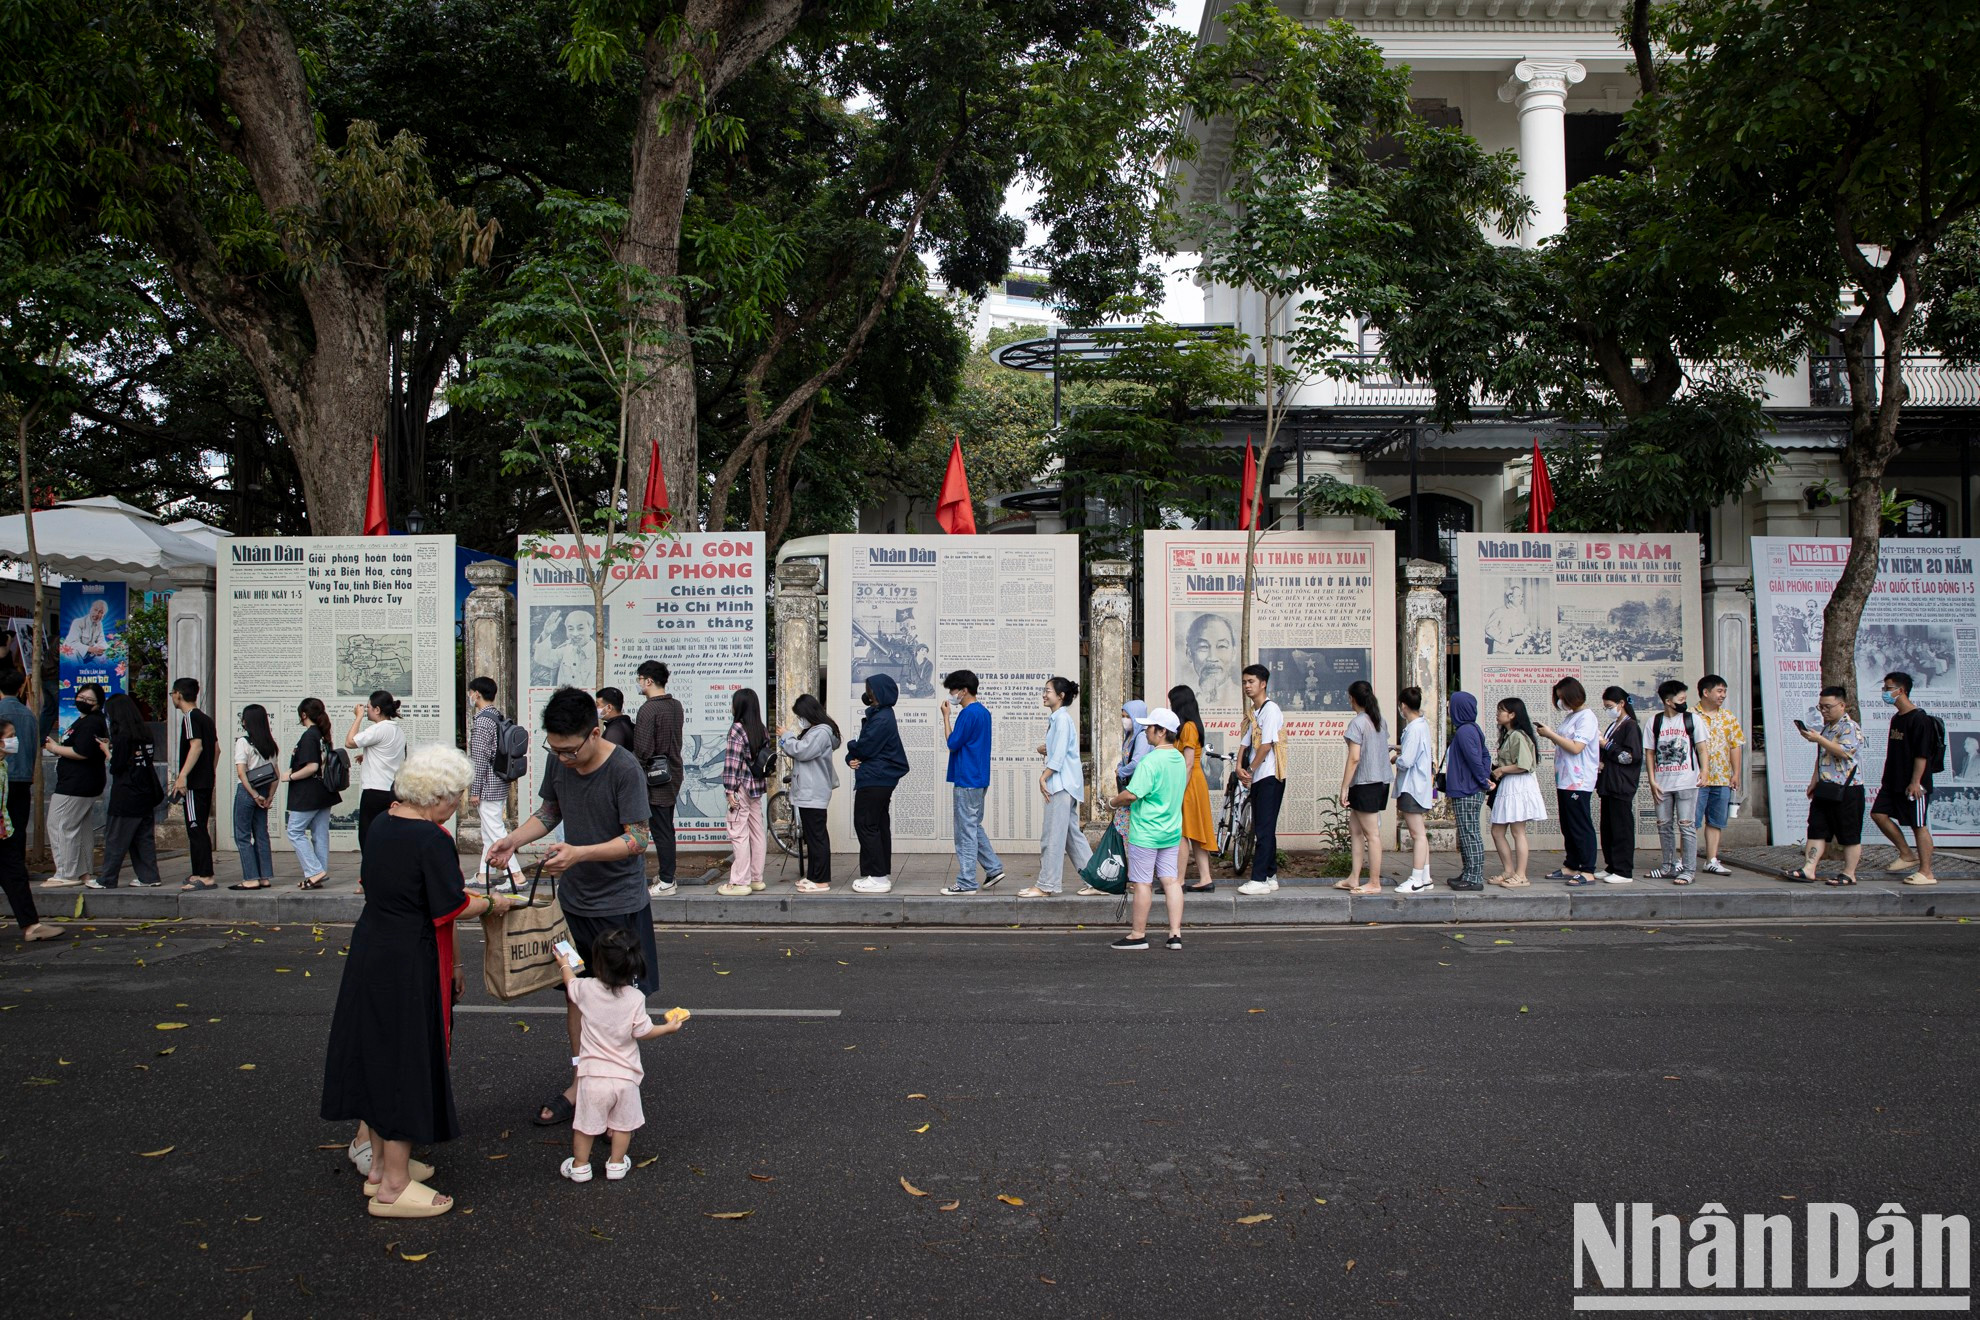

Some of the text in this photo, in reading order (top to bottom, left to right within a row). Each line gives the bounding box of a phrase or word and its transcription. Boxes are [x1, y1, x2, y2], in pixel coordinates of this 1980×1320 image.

[232, 545, 304, 562] Nhân Dân
[656, 541, 692, 558] SÀI
[702, 540, 753, 557] GÒN
[870, 548, 906, 562] Nhân
[910, 548, 936, 562] Dân
[1478, 541, 1552, 558] Nhân Dân
[1586, 542, 1672, 559] 15 NĂM
[1790, 545, 1832, 561] Nhân
[309, 553, 412, 564] Giải phóng hoàn toàn
[1202, 553, 1212, 564] 10
[1217, 552, 1240, 564] NĂM
[1268, 551, 1303, 564] THẮNG
[1308, 552, 1332, 564] MÙA
[1337, 552, 1366, 564] XUÂN
[611, 561, 752, 579] GIẢI PHÓNG
[1556, 561, 1572, 570] NGÀY
[1578, 560, 1598, 570] THẮNG
[1603, 561, 1615, 571] LỢI
[1620, 561, 1638, 570] HOÀN
[1642, 561, 1658, 570] TOÀN
[1664, 562, 1681, 571] CUỘC
[1891, 556, 1923, 574] NIỆM
[1926, 559, 1942, 574] 20
[1946, 556, 1972, 573] NĂM
[309, 567, 319, 578] thị
[341, 567, 360, 576] Biên
[366, 567, 385, 577] Hòa,
[391, 567, 412, 578] cảng
[533, 568, 572, 583] Nhân
[1556, 573, 1681, 583] KHÁNG CHIẾN CHỐNG MỸ, CỨU NƯỚC
[309, 580, 412, 592] Vũng Tàu, tỉnh Biên Hòa
[1187, 575, 1224, 591] Nhân
[1257, 575, 1371, 587] MÍT-TINH LỚN Ở HÀ NỘI
[1769, 577, 1833, 592] GIẢI PHÓNG MIỀN
[1890, 578, 1910, 593] QUỐC
[1912, 578, 1920, 593] TẾ
[1922, 582, 1936, 593] LAO
[1938, 579, 1960, 595] ĐỘNG
[1962, 582, 1975, 593] 1-5
[671, 585, 753, 596] Chiến dịch
[333, 594, 349, 604] tỉnh
[354, 594, 383, 604] Phước
[387, 594, 402, 605] Tuy
[657, 601, 753, 612] Hồ Chí Minh
[657, 617, 753, 630] toàn thắng
[512, 941, 538, 960] HELLO
